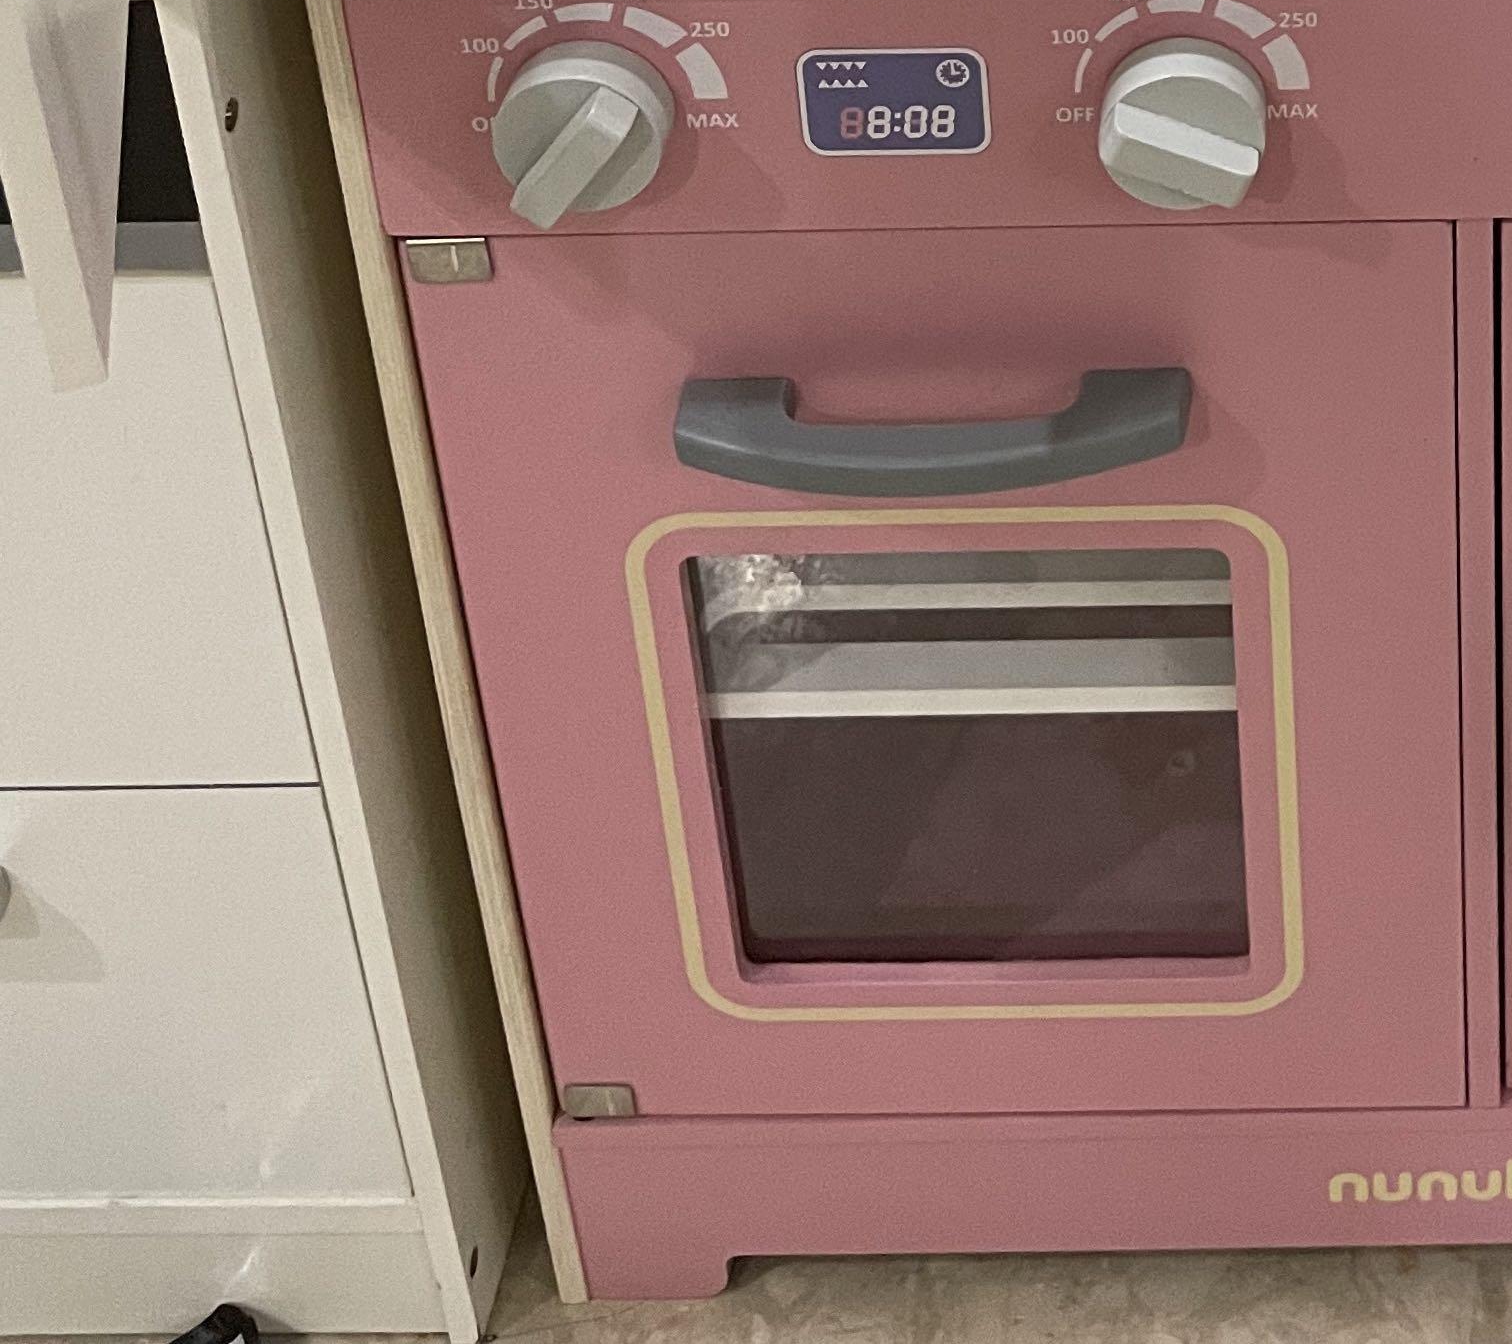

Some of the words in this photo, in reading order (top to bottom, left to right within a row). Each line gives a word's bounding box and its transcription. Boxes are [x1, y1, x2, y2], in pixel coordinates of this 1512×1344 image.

[1279, 13, 1318, 28] 250
[690, 22, 729, 38] 250
[1052, 29, 1089, 44] 100
[460, 38, 499, 54] 100
[1056, 107, 1095, 122] OFF
[1267, 103, 1319, 119] MAX
[686, 113, 739, 129] MAX
